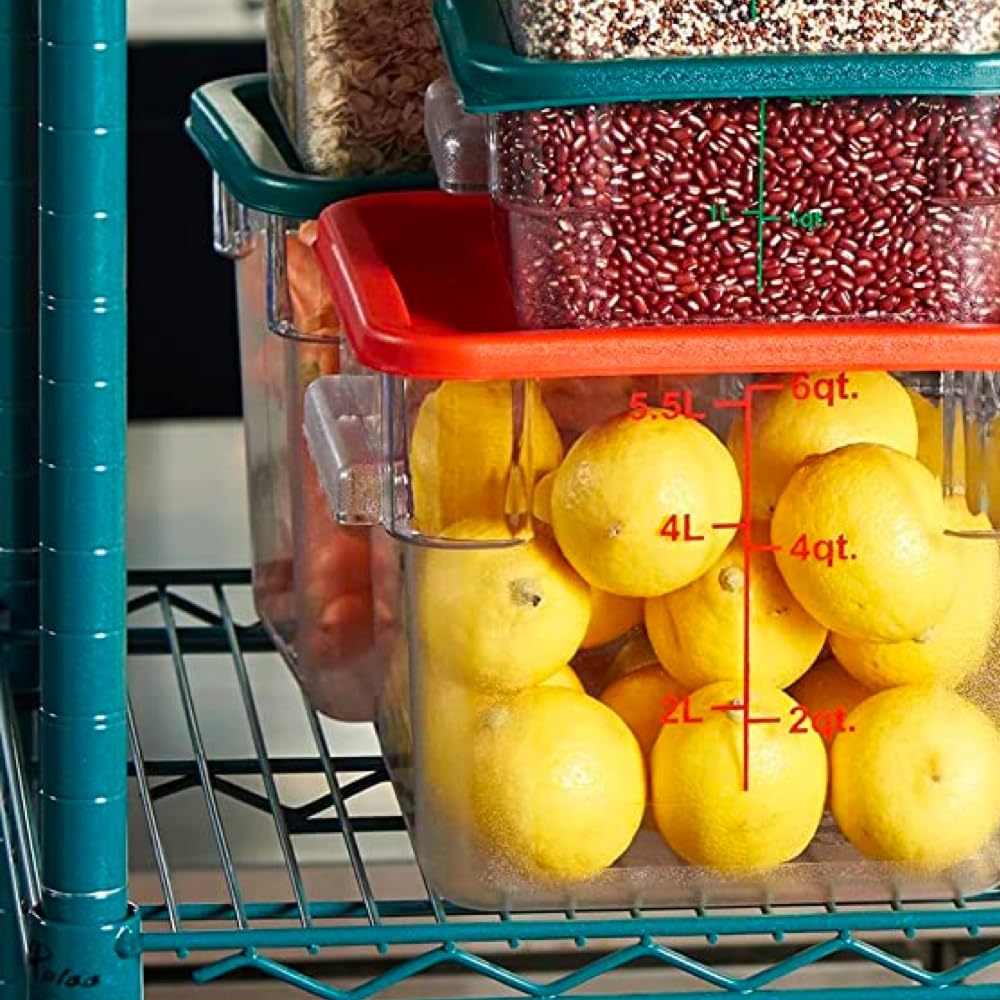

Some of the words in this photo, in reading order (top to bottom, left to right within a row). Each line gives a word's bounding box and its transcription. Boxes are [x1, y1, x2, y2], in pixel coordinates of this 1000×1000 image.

[790, 370, 859, 407] 6qt.
[629, 390, 706, 421] 5.5L
[660, 513, 705, 542] 4L
[789, 532, 858, 568] 4qt.
[661, 695, 704, 724] 2L
[788, 704, 856, 741] 2qt.
